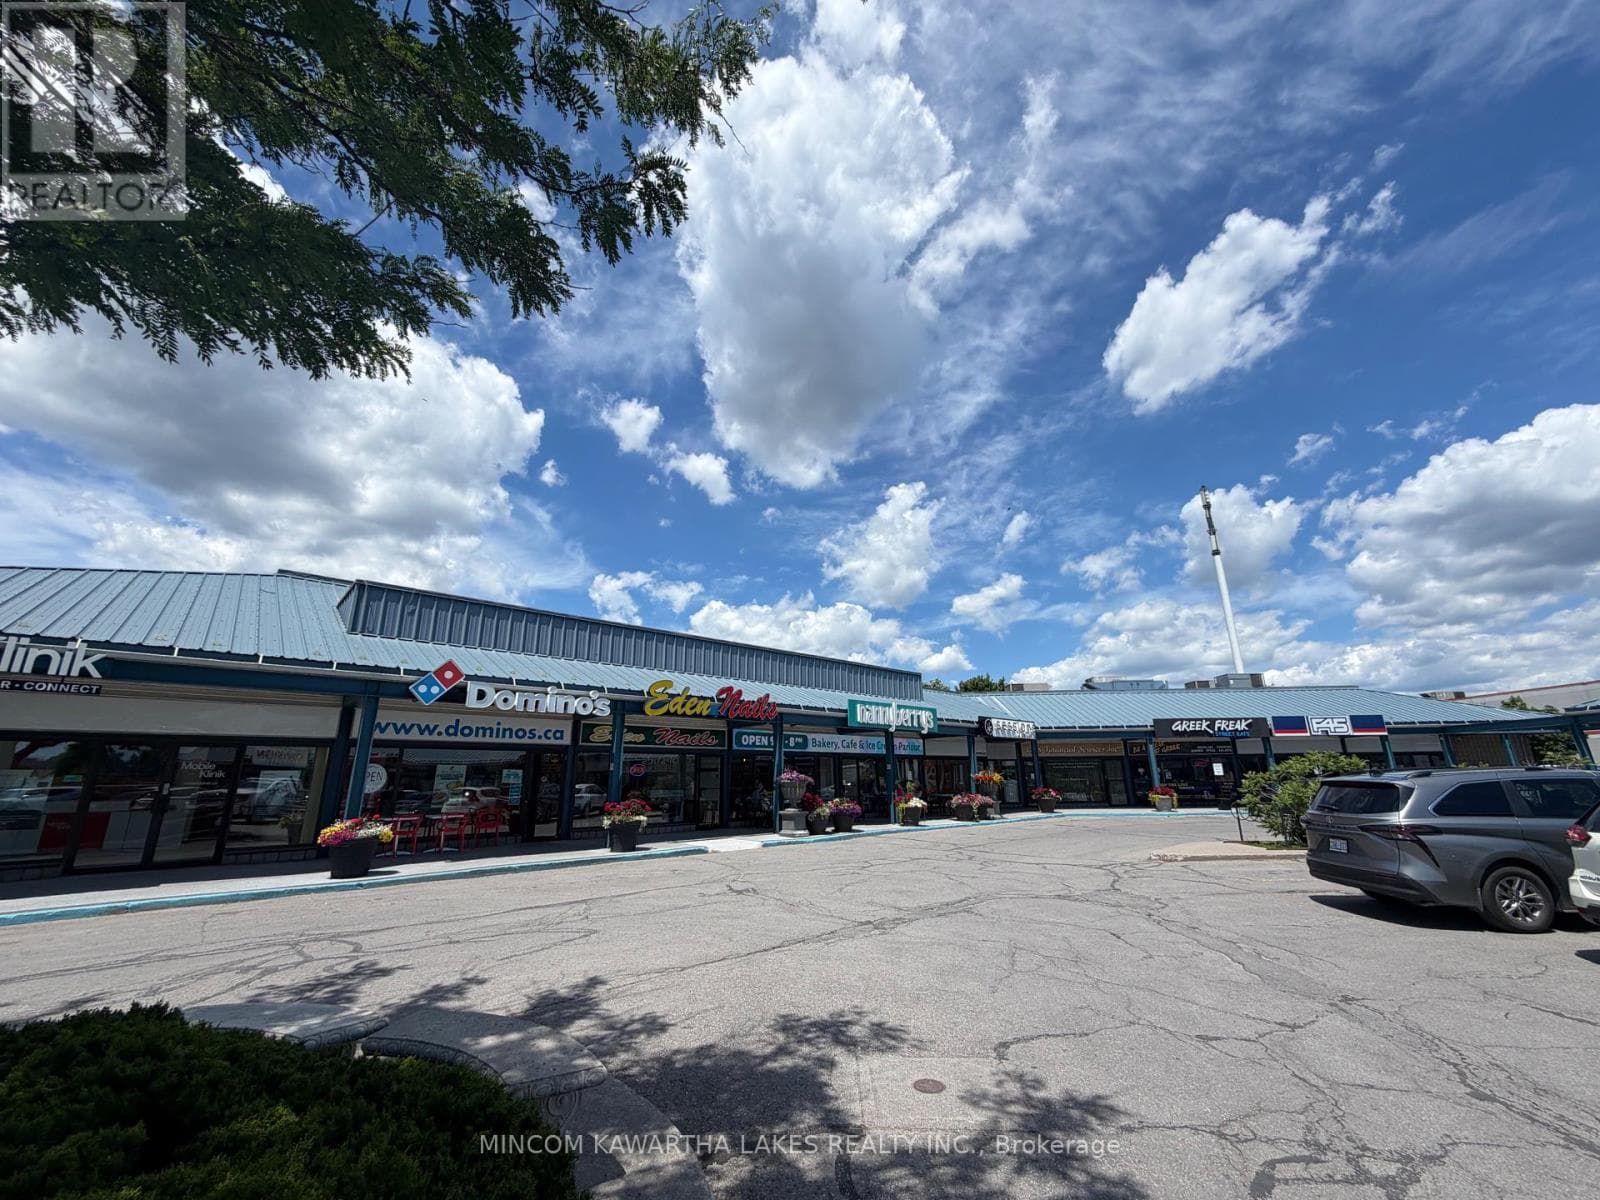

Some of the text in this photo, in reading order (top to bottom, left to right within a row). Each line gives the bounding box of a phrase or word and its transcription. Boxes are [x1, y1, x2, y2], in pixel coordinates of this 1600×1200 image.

[0, 636, 107, 679] linik
[23, 681, 100, 694] CONNECT
[465, 680, 612, 717] Domino's
[644, 679, 778, 719] Eden Nails
[1171, 719, 1253, 734] GREEK FREAK
[1311, 717, 1349, 734] F45
[589, 725, 719, 746] Een Nails
[741, 734, 768, 746] OPEN
[811, 737, 840, 750] Bakery,
[181, 760, 216, 770] Mobile
[199, 769, 226, 778] Klinik
[366, 771, 384, 782] PEN
